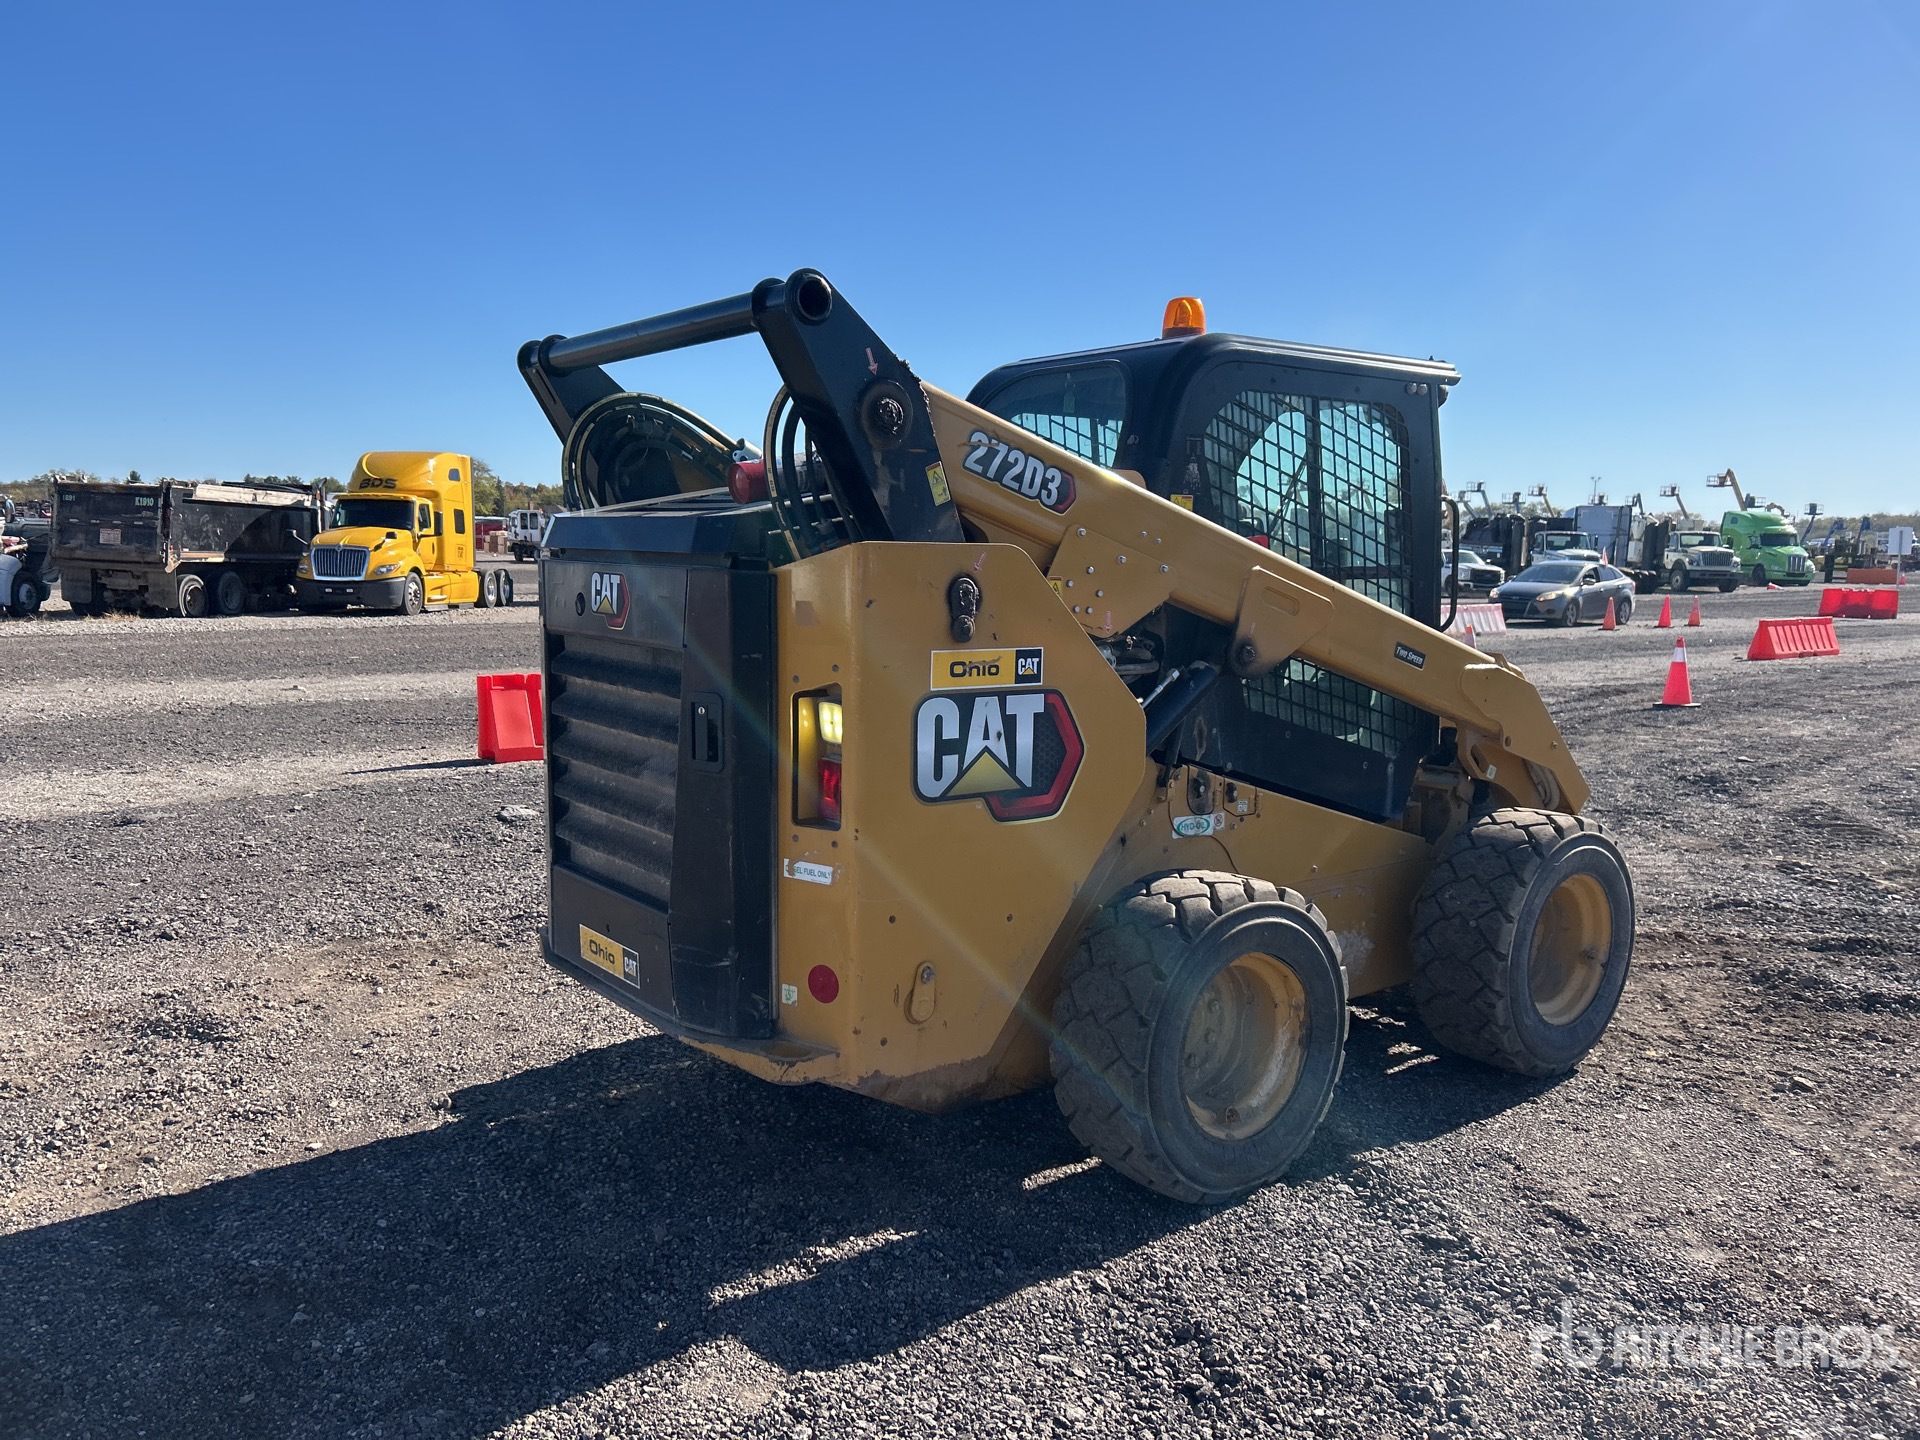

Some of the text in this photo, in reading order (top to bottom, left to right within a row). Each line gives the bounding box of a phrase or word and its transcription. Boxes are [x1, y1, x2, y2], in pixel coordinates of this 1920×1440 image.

[963, 430, 1063, 506] 272D3
[591, 572, 621, 615] CAT
[949, 657, 1040, 678] Ohio CAT
[916, 693, 1045, 798] CAT
[803, 867, 817, 877] FUEL
[817, 870, 832, 879] ONLY
[589, 939, 637, 977] Ohio CAT
